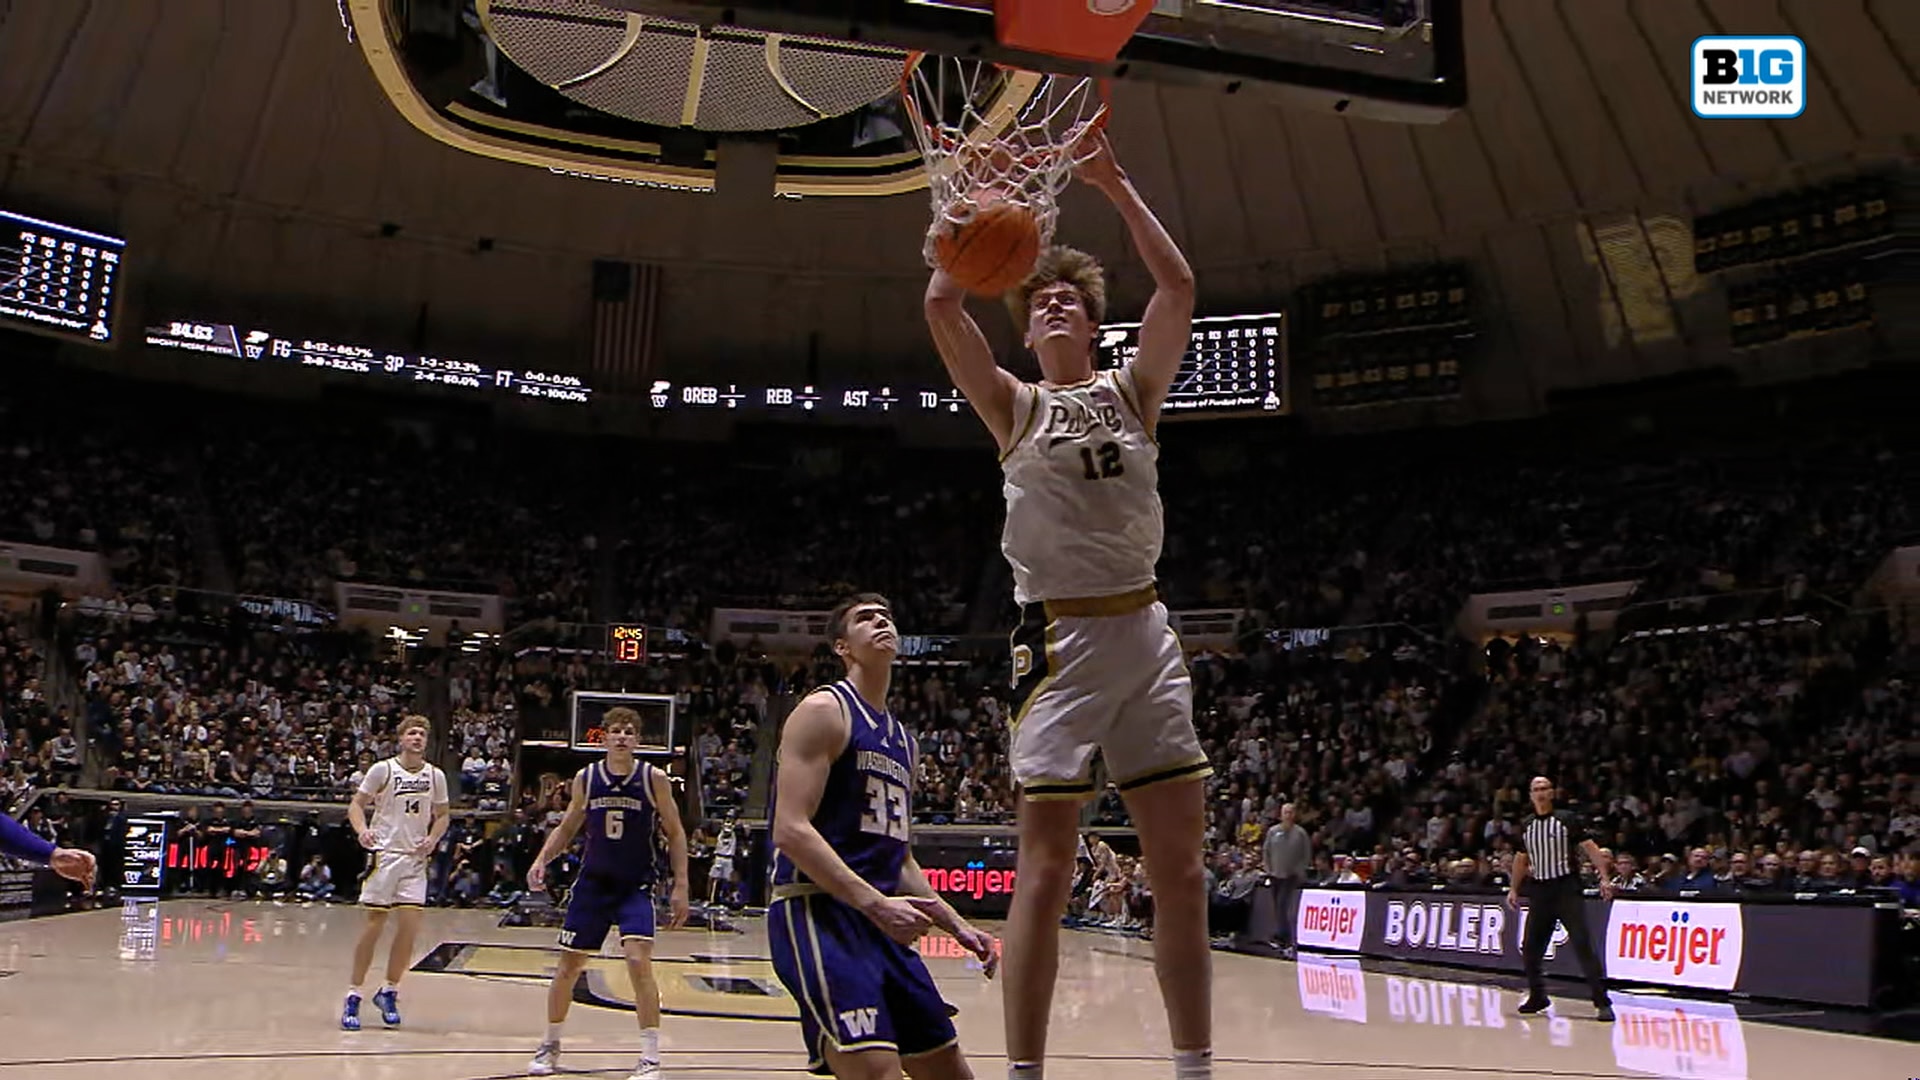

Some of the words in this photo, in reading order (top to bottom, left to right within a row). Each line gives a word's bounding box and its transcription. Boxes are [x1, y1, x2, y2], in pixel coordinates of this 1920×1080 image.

[45, 249, 53, 258] 0
[104, 264, 112, 272] 0
[63, 266, 71, 274] 0
[83, 270, 90, 279] 0
[40, 284, 48, 292] 0
[102, 286, 110, 294] 0
[58, 301, 66, 309] 0
[78, 305, 86, 314] 0
[272, 339, 292, 358] FG
[1215, 341, 1220, 350] 1
[1249, 350, 1256, 358] 0
[384, 354, 404, 372] 3P
[1216, 362, 1220, 370] 1
[1268, 358, 1274, 366] 0
[496, 370, 514, 388] FT
[1196, 374, 1203, 382] 0
[1249, 370, 1256, 378] 0
[1268, 369, 1274, 378] 0
[1232, 382, 1238, 390] 0
[682, 386, 718, 404] OREB
[766, 388, 793, 404] REB
[843, 391, 869, 407] AST
[920, 392, 938, 408] TO
[1081, 441, 1124, 480] 12
[614, 626, 642, 640] 12:45
[620, 640, 639, 660] 13
[405, 800, 420, 814] 14
[860, 775, 909, 843] 33
[606, 810, 624, 840] 6
[920, 860, 1015, 899] meijer
[1304, 897, 1358, 941] meijer
[1384, 901, 1504, 955] BOILER
[561, 930, 577, 945] W
[1618, 911, 1727, 976] meijer
[840, 1007, 878, 1038] W
